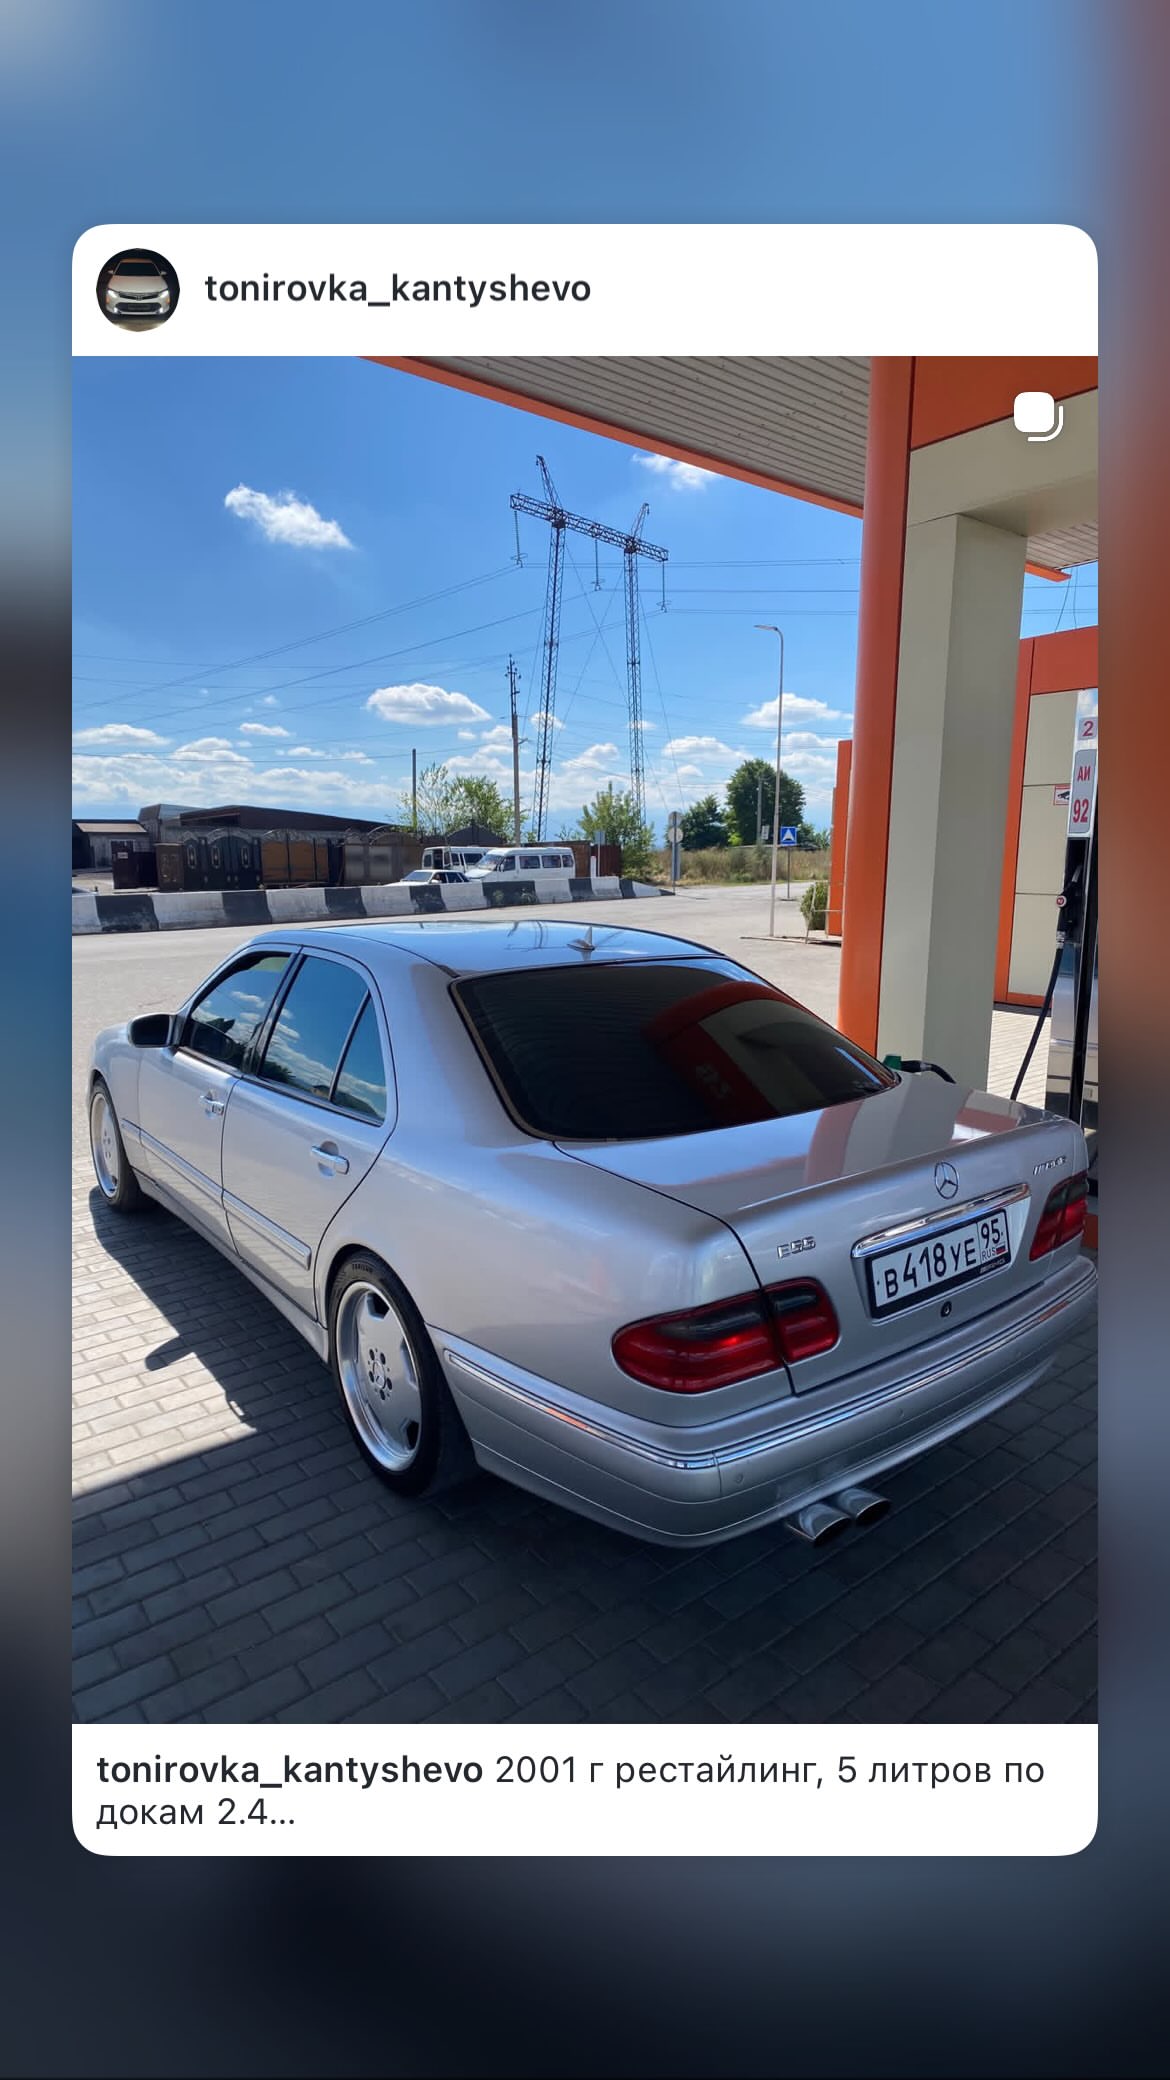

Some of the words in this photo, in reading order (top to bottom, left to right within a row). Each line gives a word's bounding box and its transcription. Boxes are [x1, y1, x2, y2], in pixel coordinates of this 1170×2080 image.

[1082, 720, 1094, 737] 2
[1077, 766, 1091, 781] АИ
[1073, 798, 1089, 823] 92
[884, 1238, 977, 1299] В418УЕ
[980, 1218, 1000, 1249] 95
[981, 1246, 996, 1261] RUS
